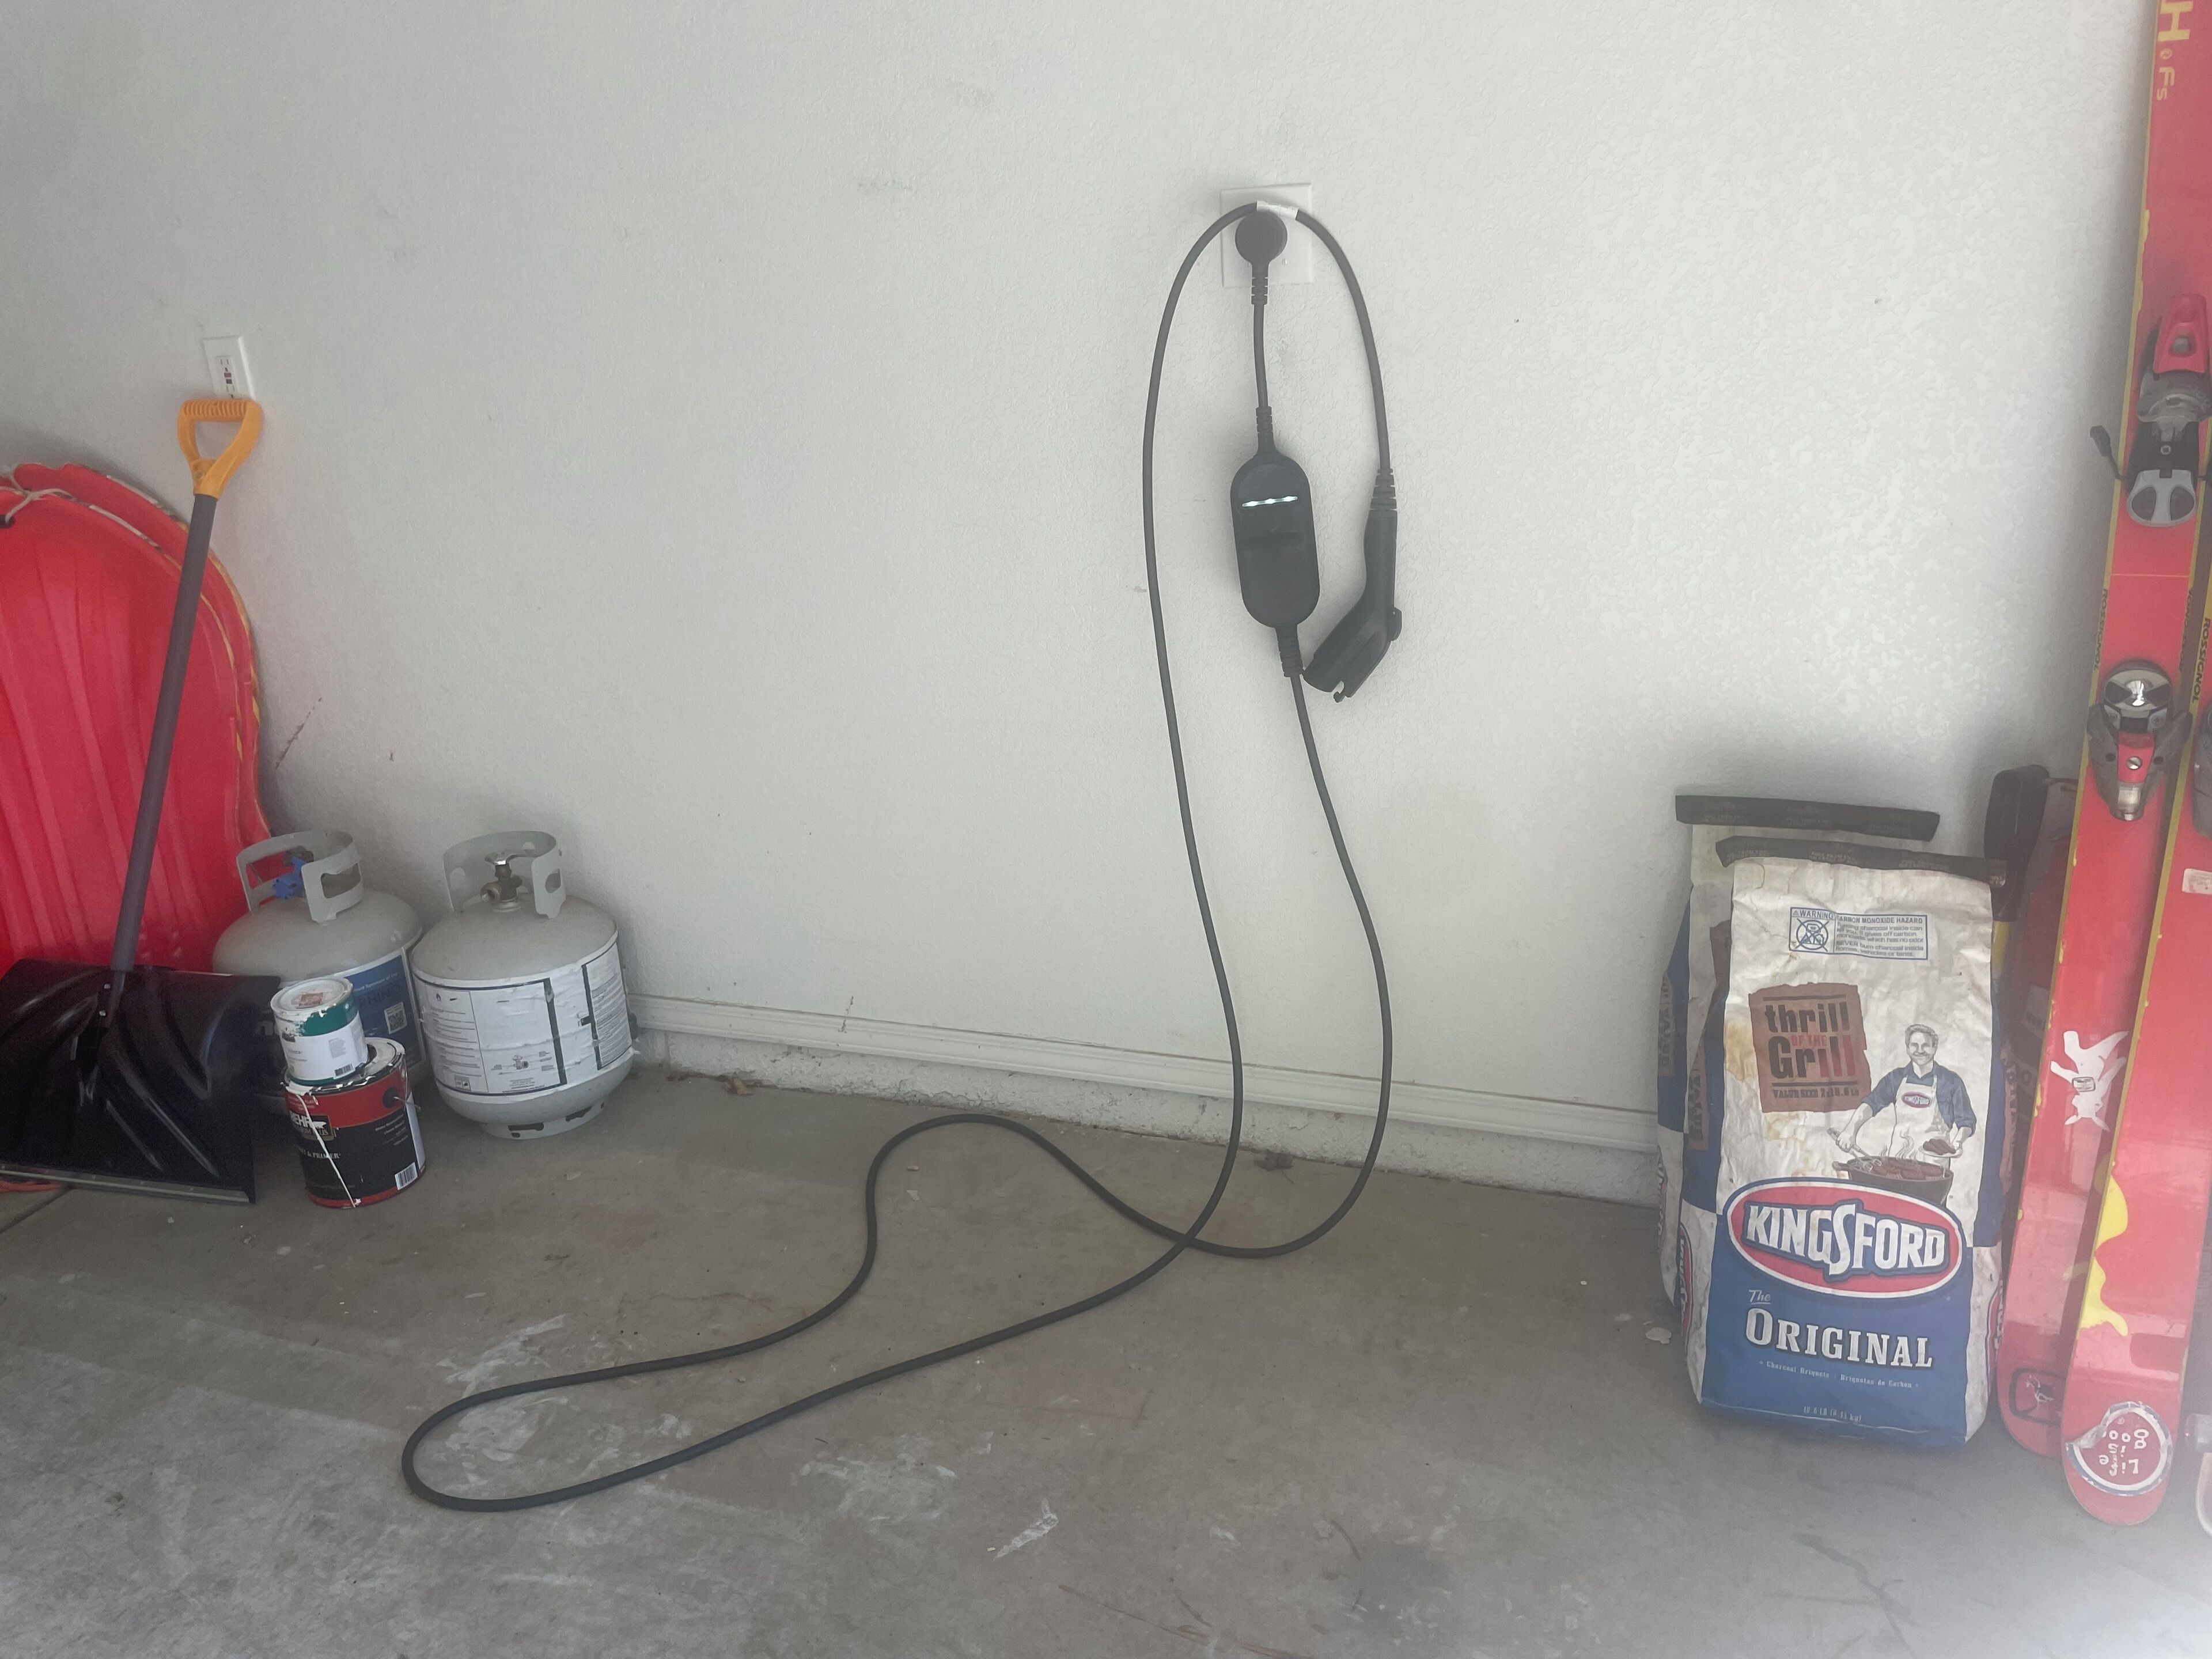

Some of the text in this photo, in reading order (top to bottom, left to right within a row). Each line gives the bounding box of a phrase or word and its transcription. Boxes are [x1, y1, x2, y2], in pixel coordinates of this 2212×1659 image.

[2192, 618, 2210, 702] ROSSIGNOL
[1800, 910, 1834, 919] WARNING
[1764, 1001, 1850, 1033] thrill
[1791, 1035, 1827, 1046] OF THE
[1768, 1035, 1855, 1079] Grill
[1747, 1204, 1945, 1275] KINGSFORD
[1748, 1289, 1771, 1303] The
[1766, 1361, 1797, 1373] Charcoal
[2103, 1429, 2149, 1449] goo
[2108, 1443, 2126, 1457] is
[2099, 1455, 2139, 1476] Life
